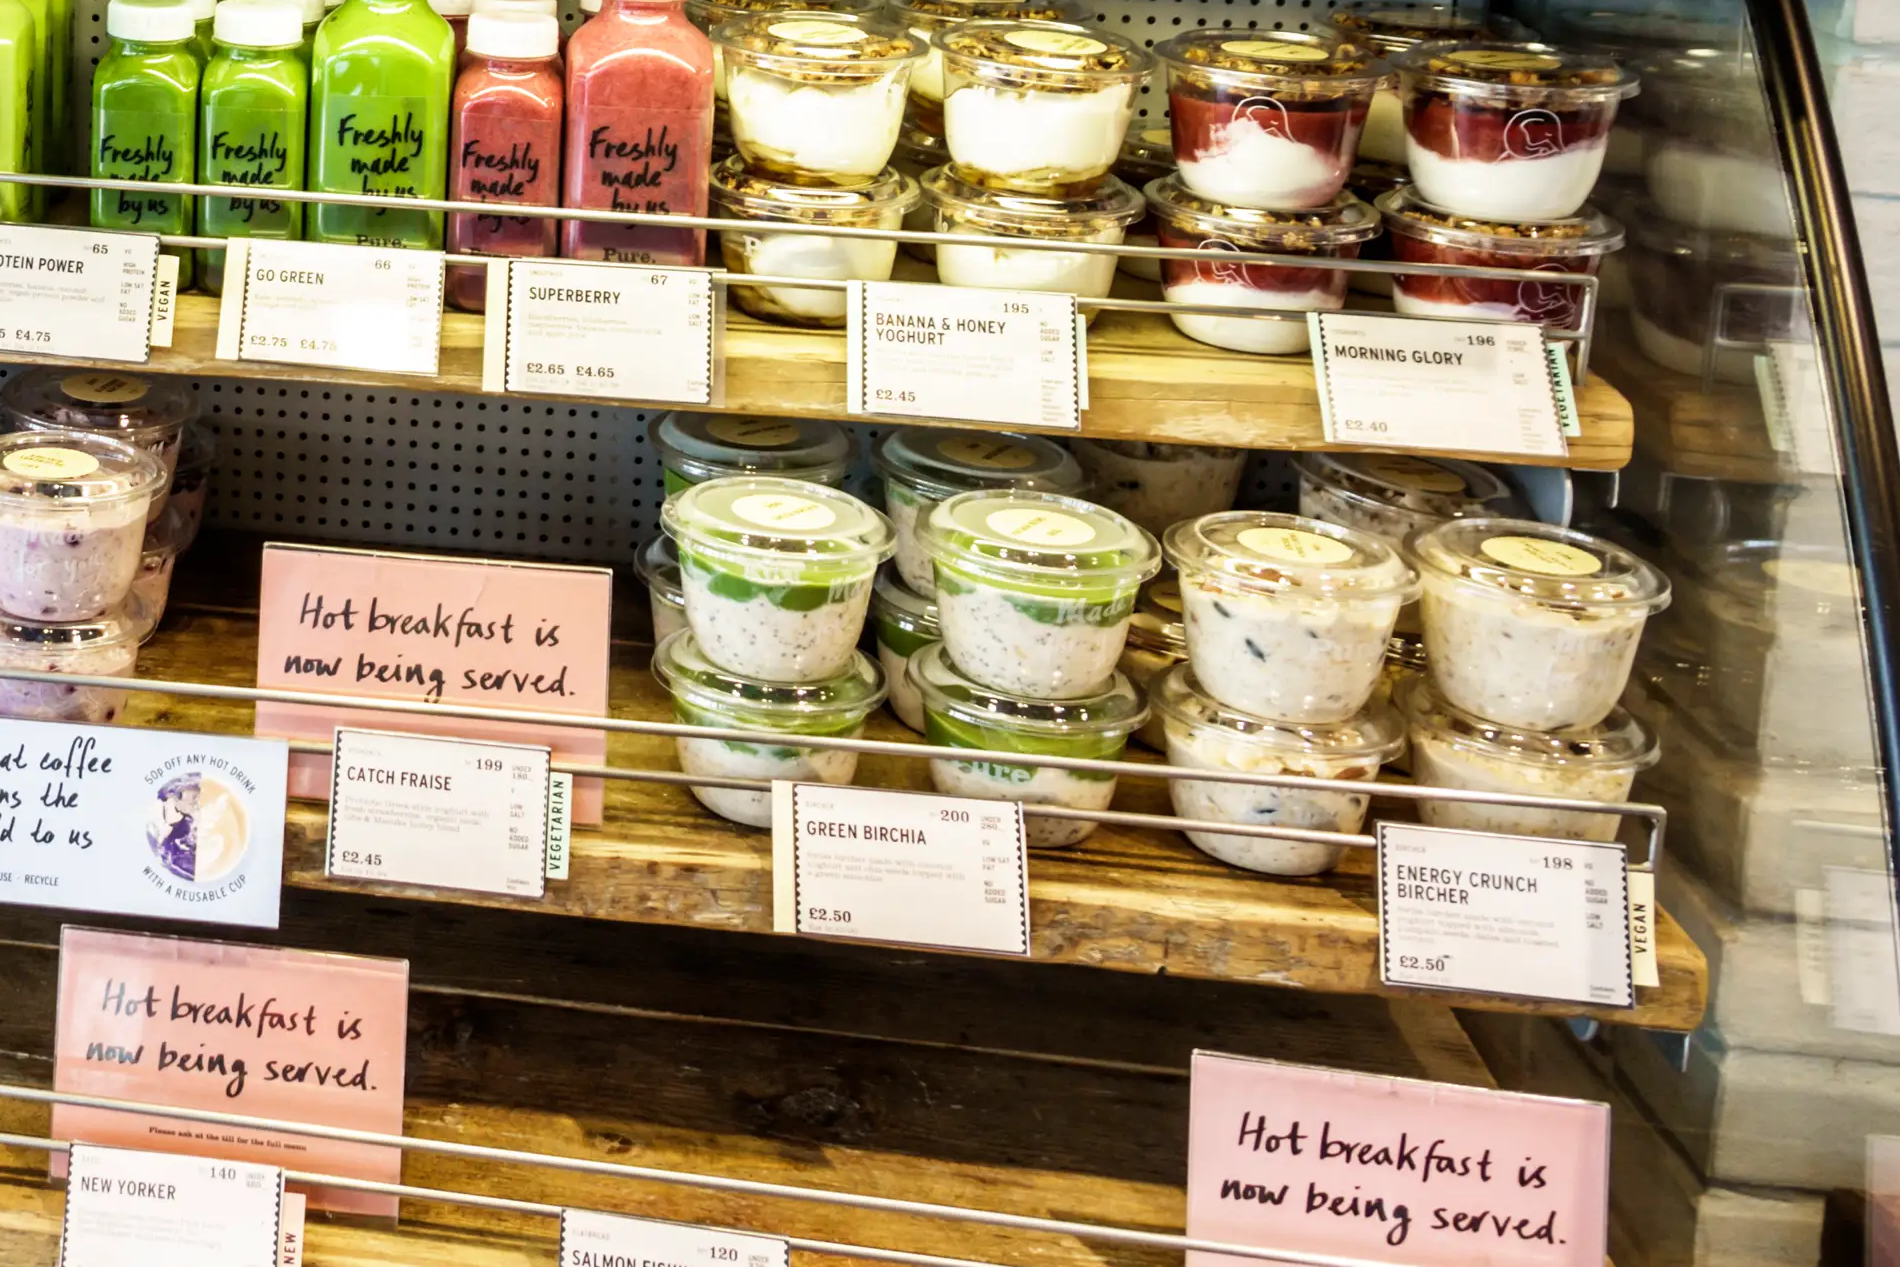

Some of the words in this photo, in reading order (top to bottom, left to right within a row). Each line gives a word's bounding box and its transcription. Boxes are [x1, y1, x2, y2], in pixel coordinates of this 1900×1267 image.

[39, 258, 84, 274] POWER
[256, 269, 275, 282] GO
[280, 270, 324, 285] GREEN
[529, 287, 621, 304] SUPERBERRY
[876, 313, 936, 329] BANANA
[942, 318, 950, 331] &
[957, 319, 1006, 335] HONEY
[876, 328, 945, 345] YOGHURT
[1335, 345, 1407, 363] MORNING
[1412, 350, 1462, 365] GLORY
[527, 362, 565, 375] £2.65
[576, 366, 615, 378] £4.65
[39, 736, 112, 778] coffee
[476, 758, 503, 771] 199
[347, 766, 395, 785] CATCH
[401, 772, 452, 791] FRAISE
[40, 782, 79, 808] the
[550, 780, 564, 870] VEGETARIAN
[940, 810, 969, 822] 200
[30, 819, 55, 845] to
[68, 828, 93, 849] us
[806, 821, 857, 839] GREEN
[864, 825, 927, 845] BIRCHIA
[342, 851, 382, 866] £2.45
[1543, 856, 1573, 870] 198
[25, 874, 59, 886] RECYCLE
[1397, 865, 1462, 885] ENERGY
[1469, 872, 1538, 893] CRUNCH
[1397, 883, 1469, 904] BIRCHER
[809, 907, 851, 922] £2.50
[1634, 903, 1647, 953] VEGAN
[1400, 955, 1445, 971] £2.50
[1238, 1112, 1307, 1155] Hot
[1319, 1122, 1492, 1183] breakfast
[1518, 1157, 1547, 1189] is
[81, 1176, 113, 1193] NEW
[117, 1180, 176, 1200] YORKER
[1221, 1179, 1289, 1206] now
[1306, 1182, 1412, 1246] being
[1431, 1207, 1566, 1245] served.
[710, 1246, 737, 1262] 120
